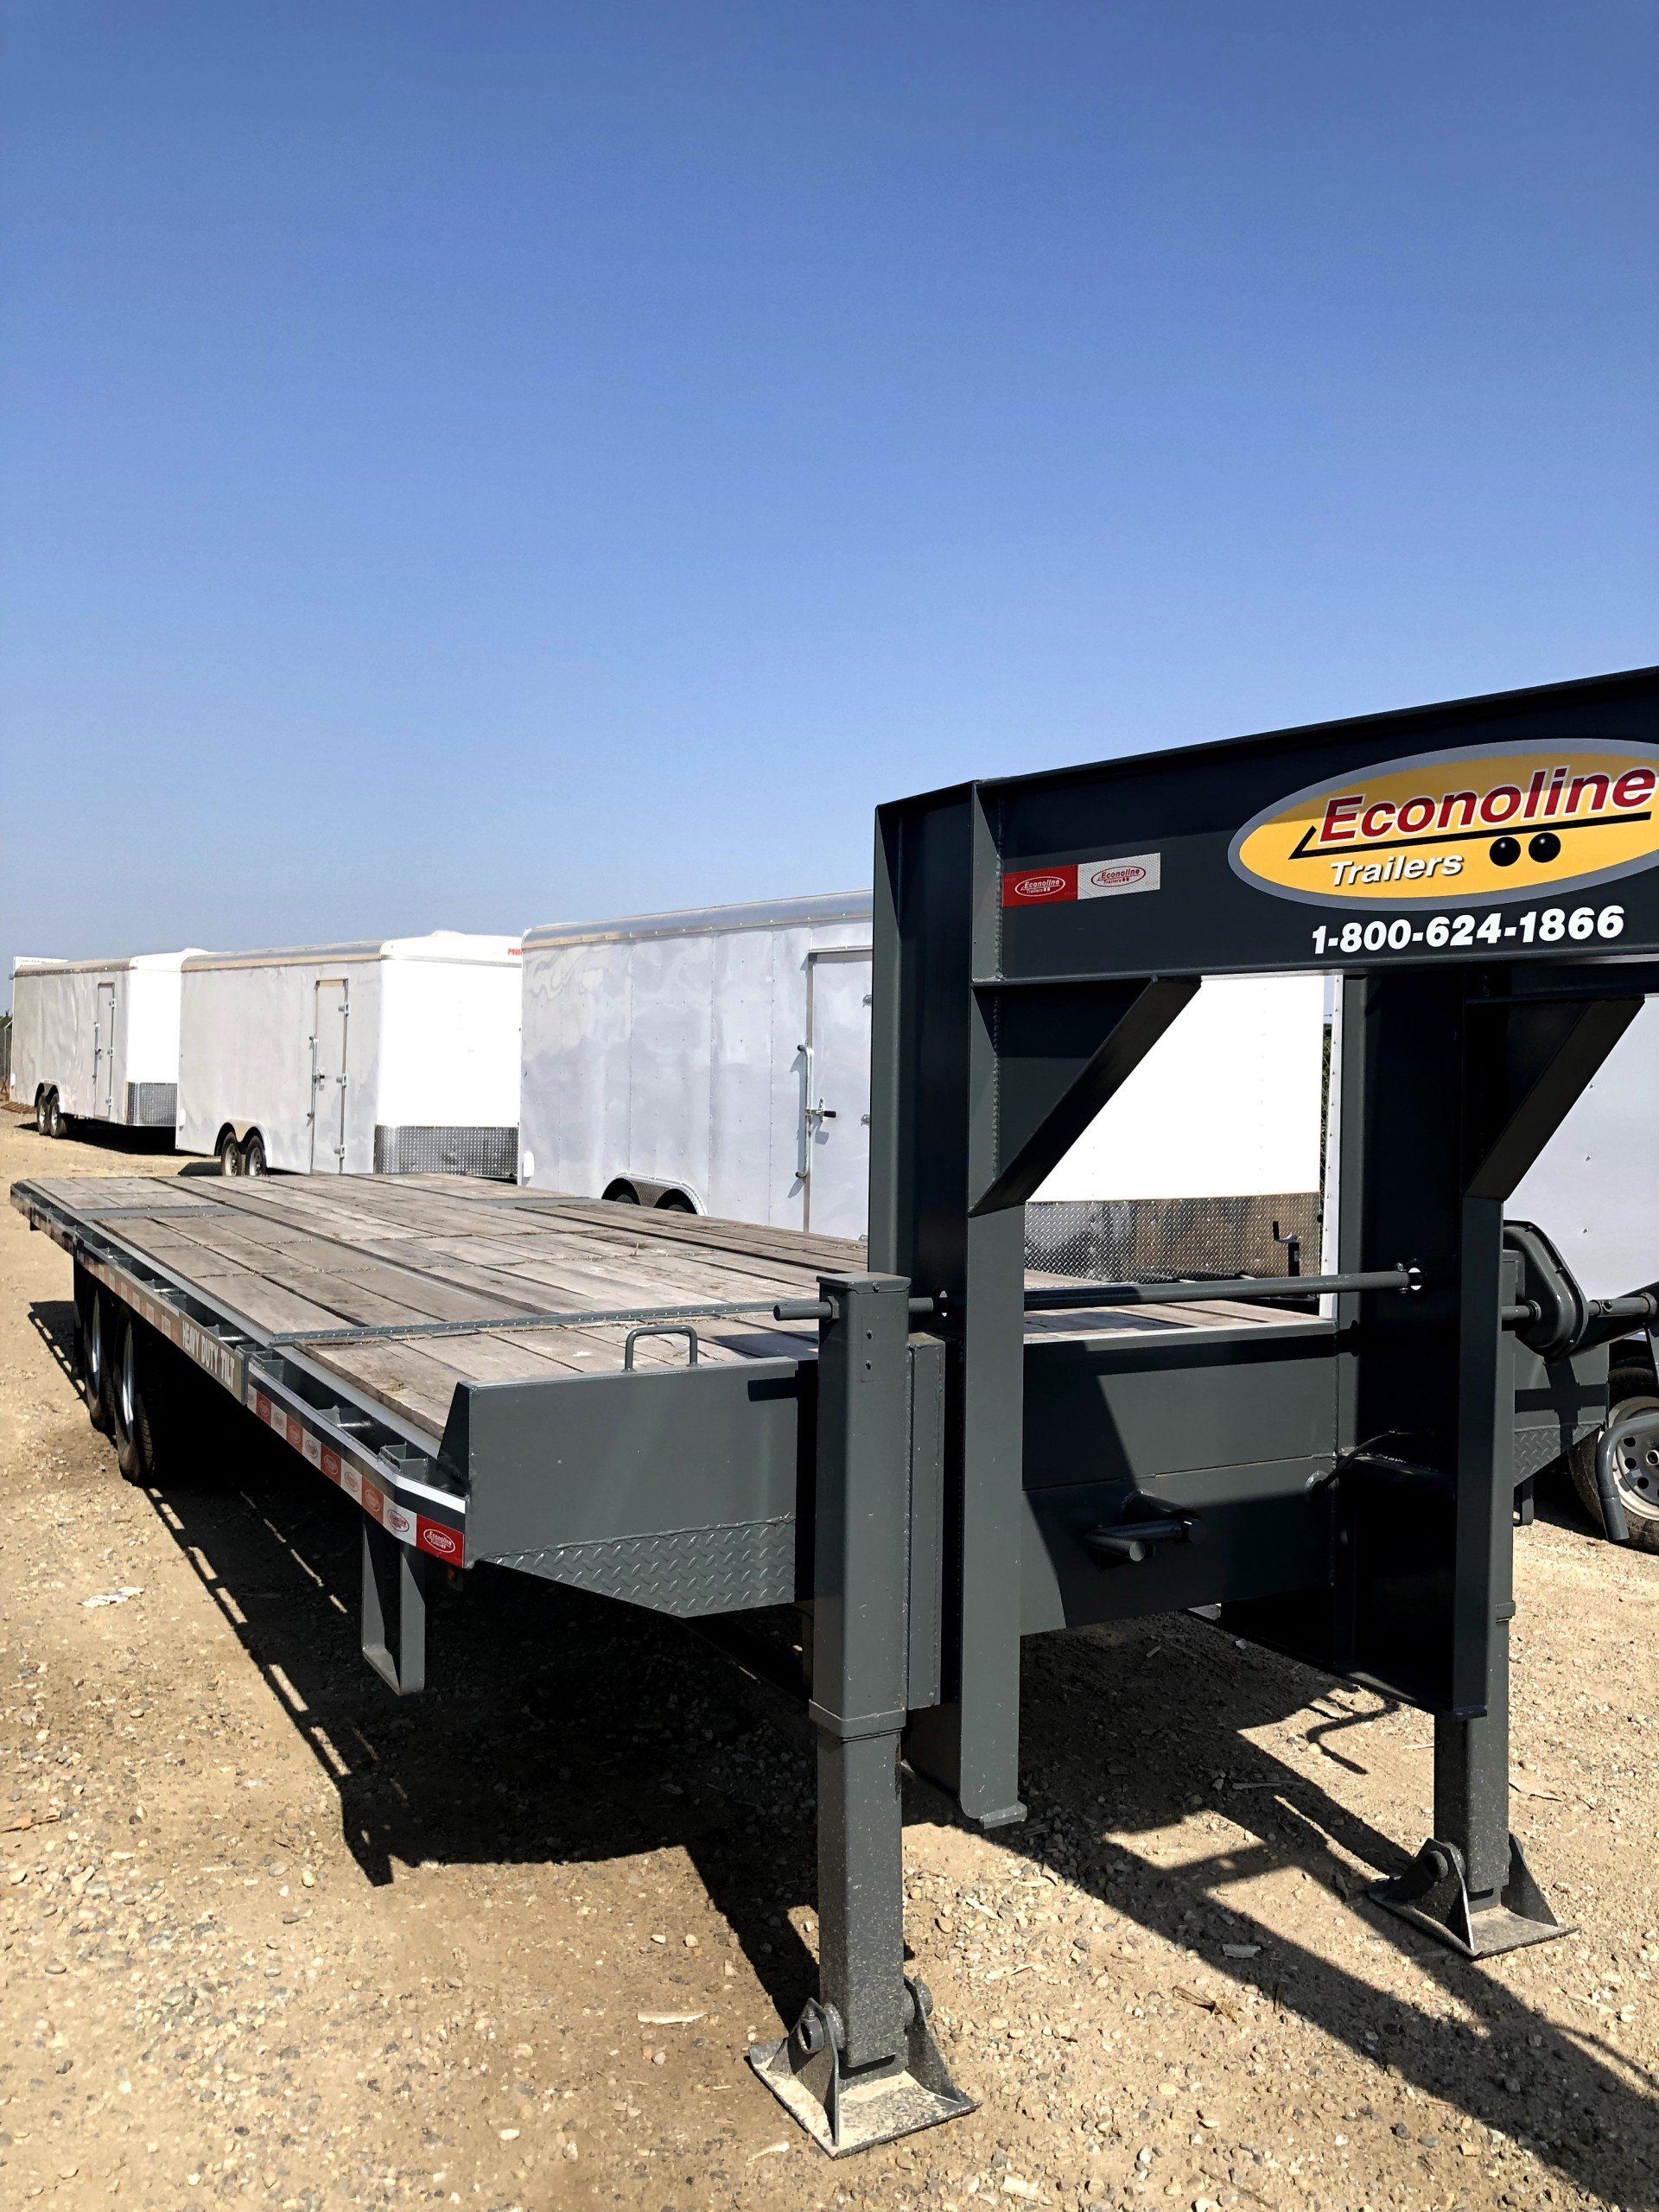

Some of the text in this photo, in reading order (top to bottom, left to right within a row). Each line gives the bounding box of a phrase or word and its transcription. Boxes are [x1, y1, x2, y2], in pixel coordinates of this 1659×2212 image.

[1319, 766, 1657, 843] Econoline
[1025, 879, 1060, 889] Econoline
[1101, 868, 1140, 880] Econoline
[1331, 855, 1464, 887] Trailers
[1312, 905, 1624, 954] 1-800-624-1866
[182, 1319, 235, 1389] HEAVY DUTY TILT
